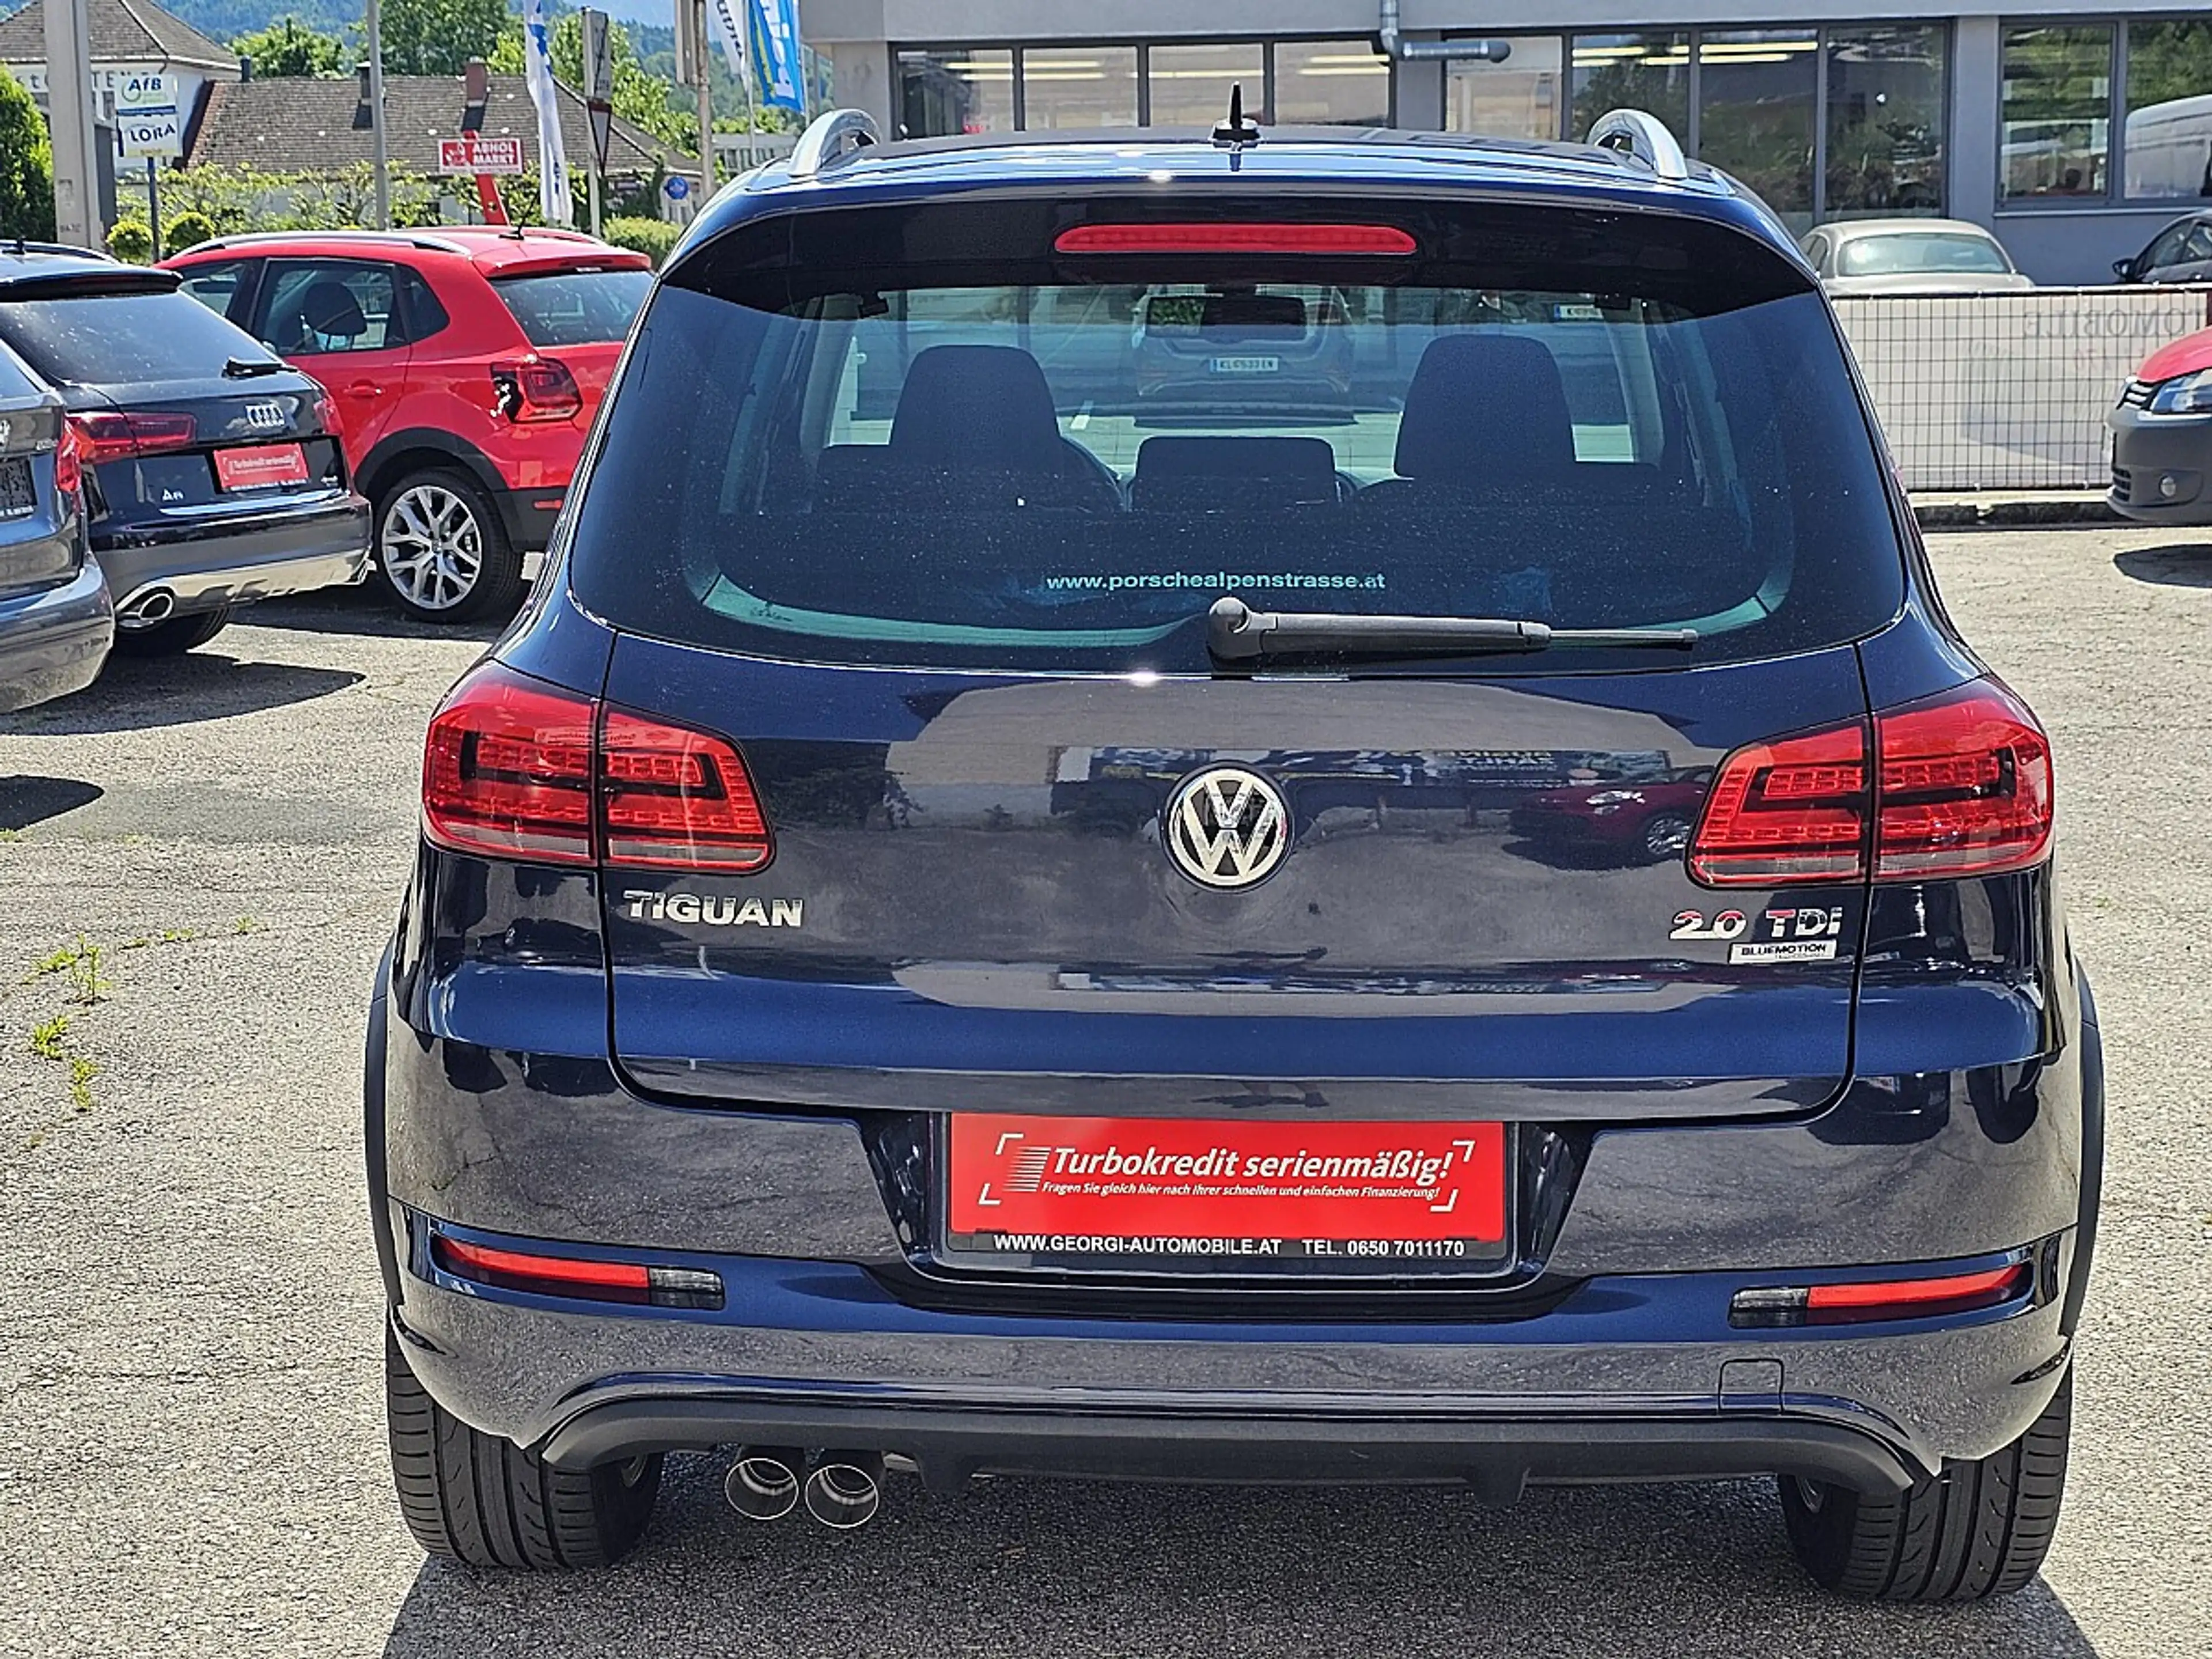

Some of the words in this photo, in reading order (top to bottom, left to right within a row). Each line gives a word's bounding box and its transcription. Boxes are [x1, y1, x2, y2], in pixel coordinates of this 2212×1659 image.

[128, 77, 162, 91] AfB
[473, 154, 514, 164] MARKT
[1046, 571, 1385, 590] www.porschealpenstrasse.at
[623, 890, 803, 927] TIGUAN
[1741, 943, 1827, 956] BLUEMOTION
[1054, 1147, 1238, 1177] Turbokredit
[1242, 1150, 1454, 1186] serienmäßig!
[1041, 1181, 1081, 1196] Fragen
[1084, 1183, 1100, 1194] Sie
[1101, 1183, 1136, 1196] gleich
[1138, 1183, 1161, 1195] hier
[1163, 1184, 1191, 1195] nach
[1192, 1184, 1222, 1196] Ihrer
[1223, 1184, 1277, 1196] schnellen
[1279, 1185, 1301, 1197] und
[1303, 1185, 1358, 1198] einfachen
[1361, 1186, 1441, 1201] Finanzierung!
[993, 1234, 1282, 1255] WWW.GEORGI-AUTOMOBILE.AT
[1301, 1238, 1342, 1255] TEL.
[1347, 1240, 1389, 1256] 0650
[1393, 1240, 1464, 1256] 7011170
